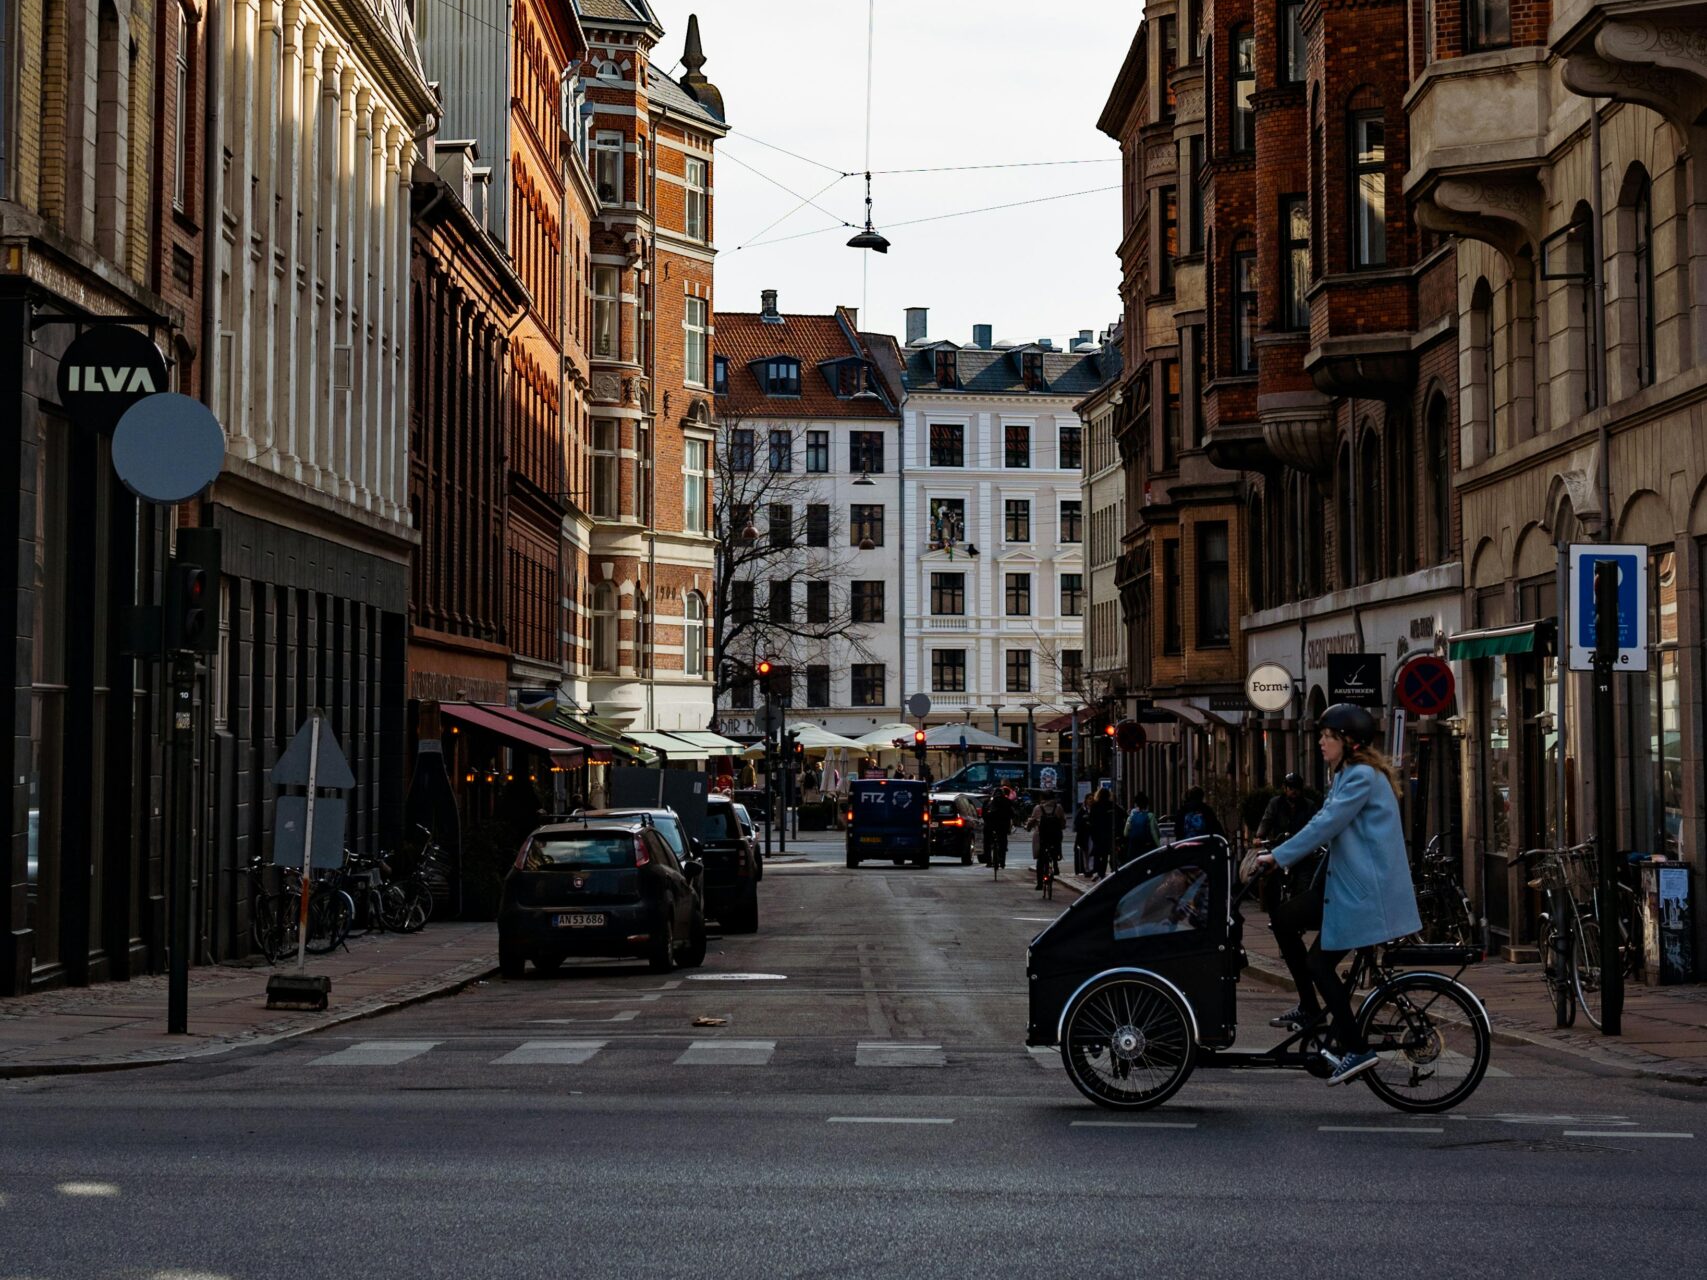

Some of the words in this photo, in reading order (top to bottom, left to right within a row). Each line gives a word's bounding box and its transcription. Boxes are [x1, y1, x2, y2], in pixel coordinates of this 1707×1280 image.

[68, 365, 156, 392] ILVA
[1253, 681, 1290, 692] Form+
[179, 691, 189, 699] 10
[720, 718, 740, 735] BAR
[861, 792, 885, 803] FTZ
[560, 915, 571, 924] AN
[573, 915, 584, 924] 53
[586, 915, 603, 924] 686
